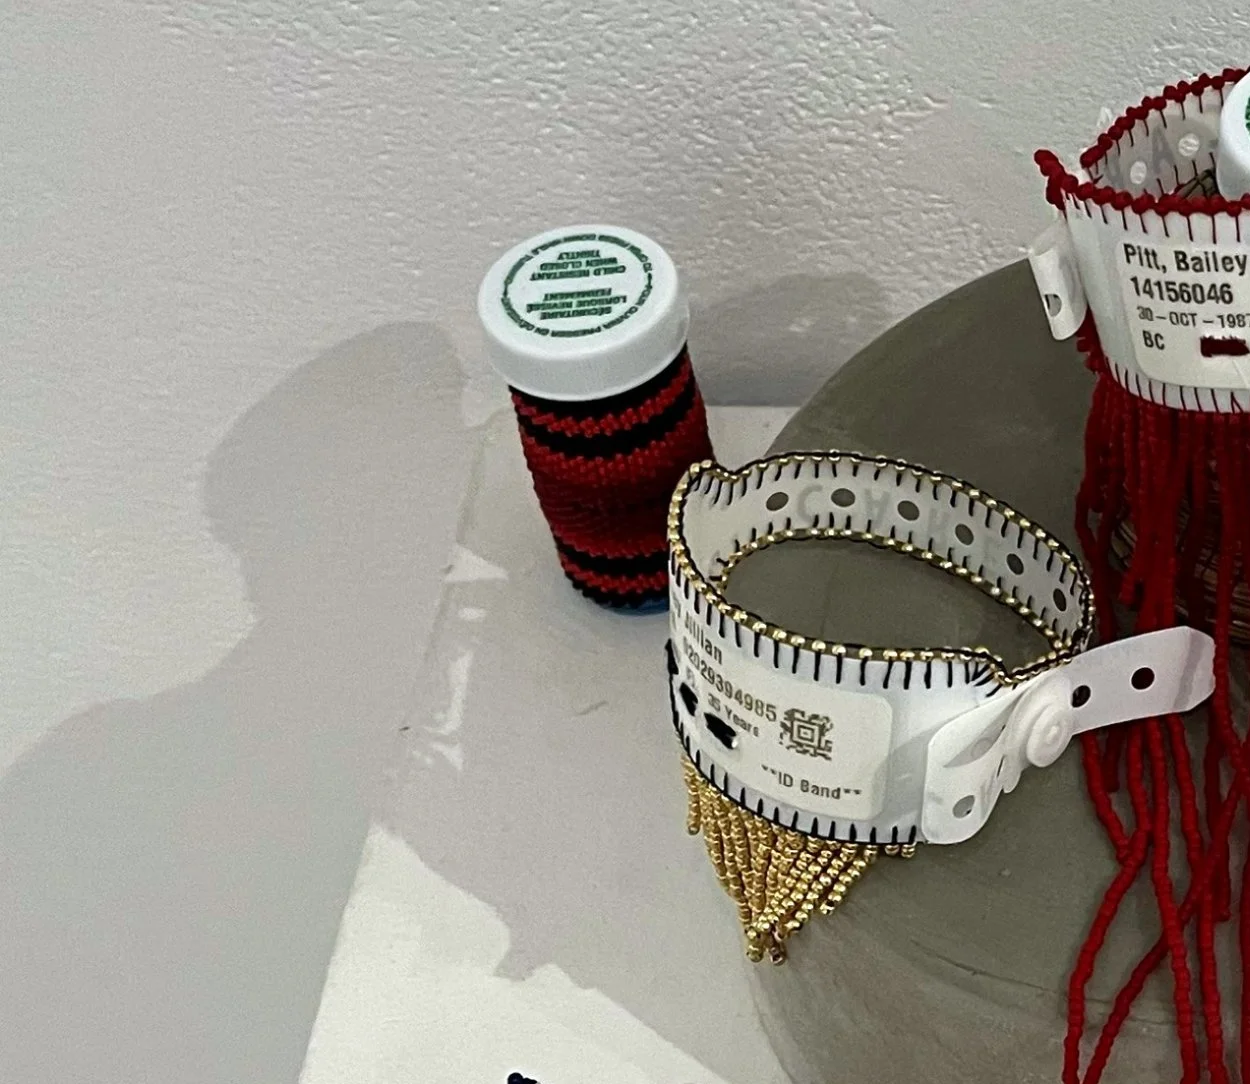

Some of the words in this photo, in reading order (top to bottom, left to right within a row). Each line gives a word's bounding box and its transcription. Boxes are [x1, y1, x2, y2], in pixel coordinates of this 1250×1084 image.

[1124, 243, 1167, 274] Pitt,
[1175, 250, 1248, 276] Bailey
[1130, 276, 1233, 304] 14156046
[1142, 330, 1165, 351] BC
